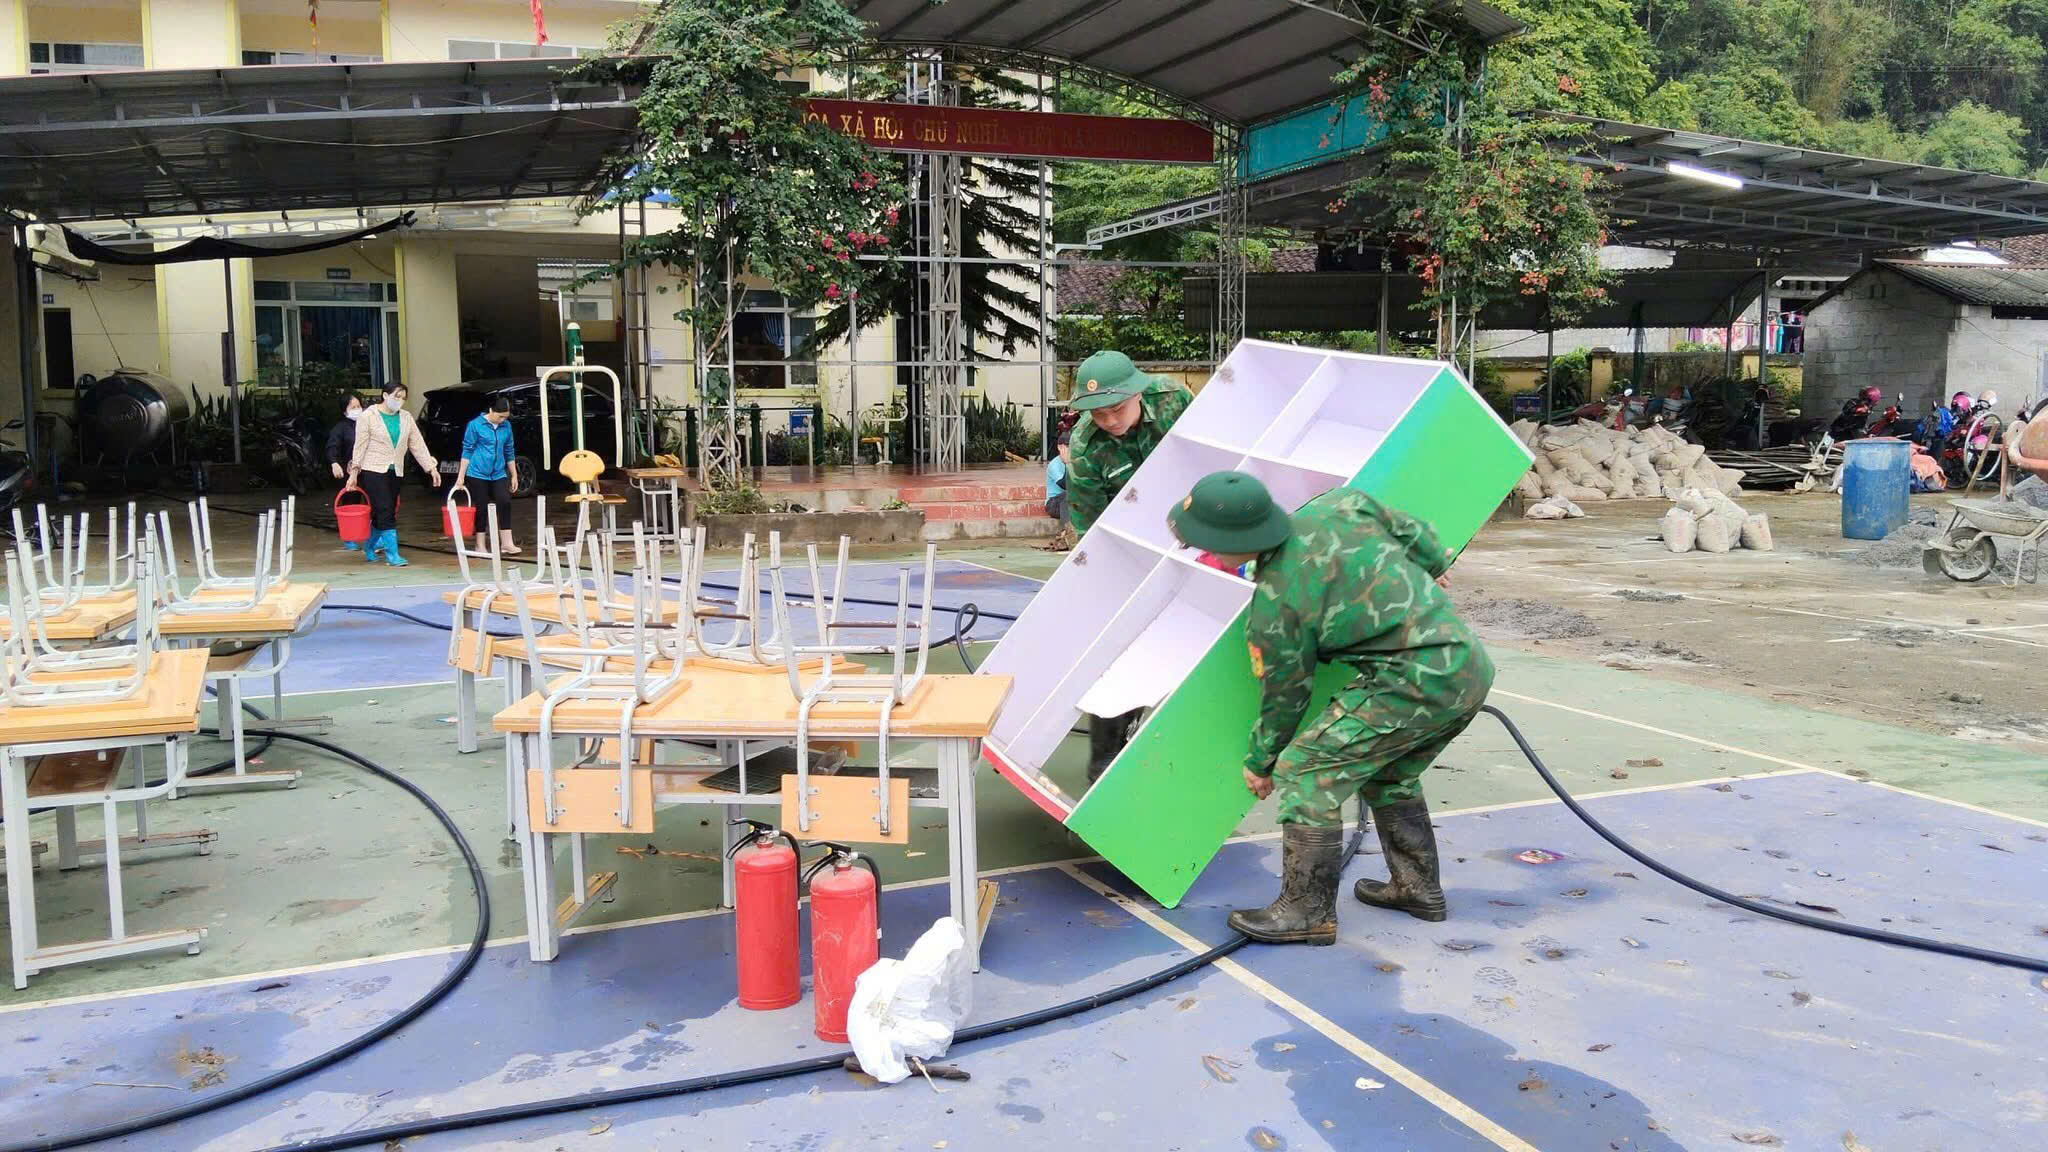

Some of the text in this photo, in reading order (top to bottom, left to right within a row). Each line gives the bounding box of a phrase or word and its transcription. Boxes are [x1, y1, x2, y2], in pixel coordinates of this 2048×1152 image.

[840, 110, 866, 137] XÃ
[873, 111, 903, 145] HỘI
[913, 111, 947, 143] CHỦ
